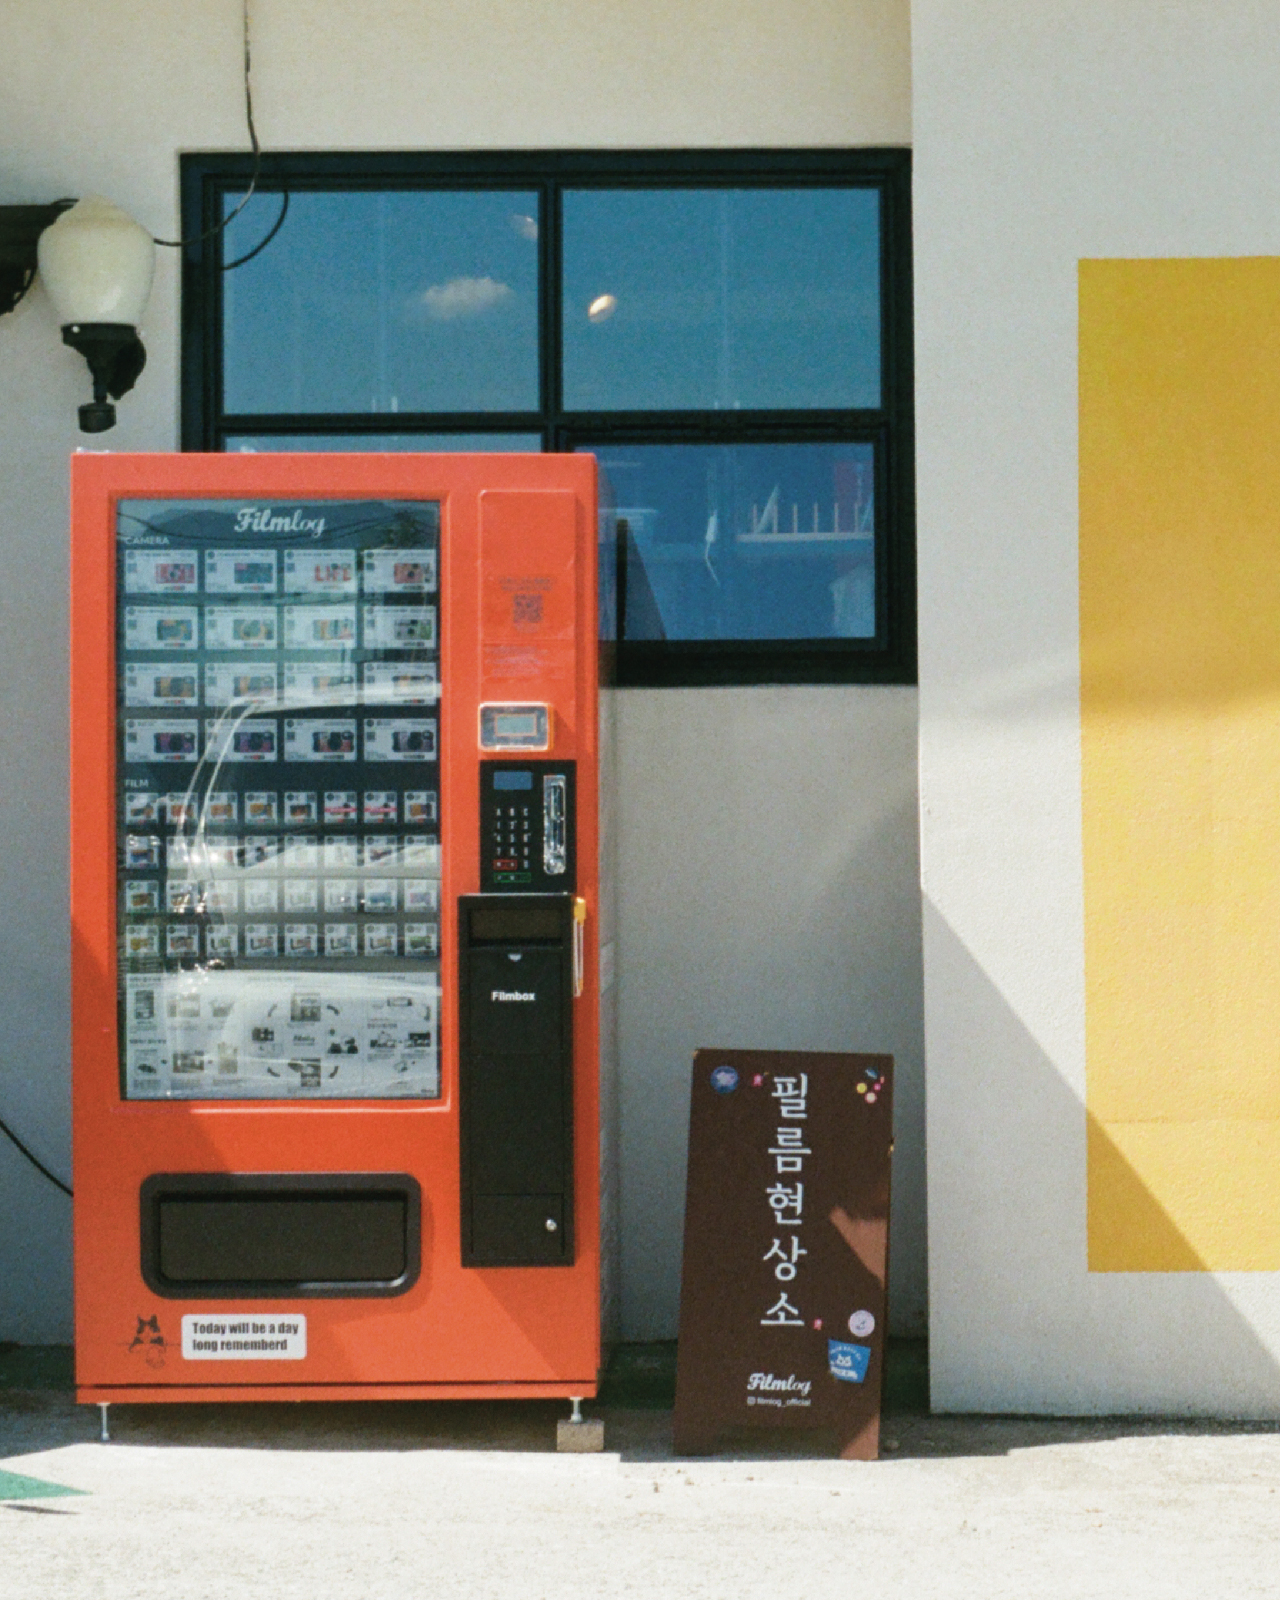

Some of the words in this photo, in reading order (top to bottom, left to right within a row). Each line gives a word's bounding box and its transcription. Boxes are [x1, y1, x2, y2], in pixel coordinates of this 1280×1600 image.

[234, 508, 326, 538] Filmlog
[491, 990, 536, 1001] Filmbox
[760, 1073, 812, 1326] 필름현상소
[192, 1322, 226, 1335] Today
[228, 1322, 249, 1334] will
[252, 1322, 266, 1334] be
[268, 1323, 275, 1334] a
[278, 1322, 299, 1335] day
[192, 1339, 218, 1351] long
[220, 1339, 288, 1351] rememberd
[747, 1373, 812, 1396] Filmlog
